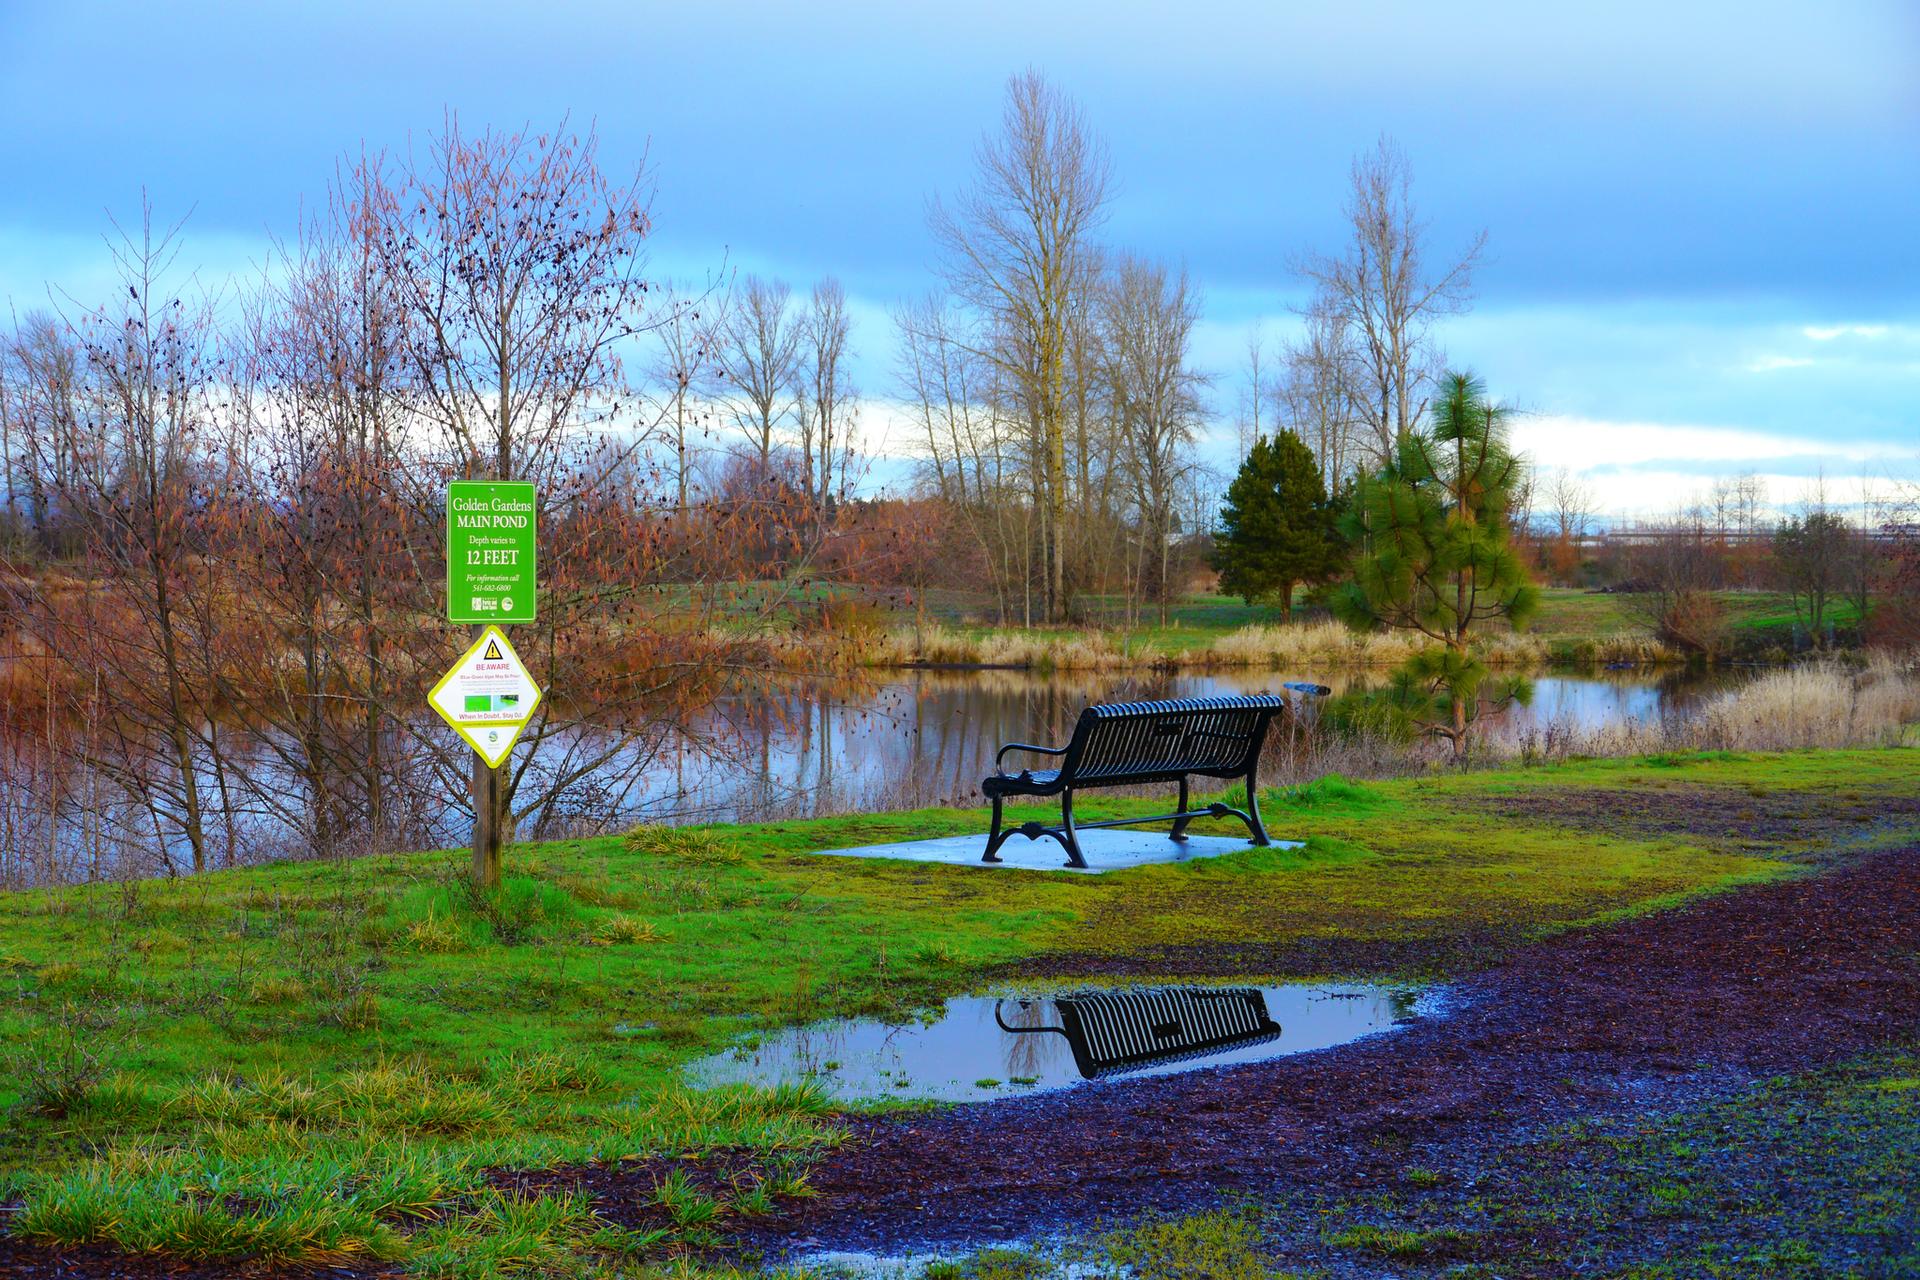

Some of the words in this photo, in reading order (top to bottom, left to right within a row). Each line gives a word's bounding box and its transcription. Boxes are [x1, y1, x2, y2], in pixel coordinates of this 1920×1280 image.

[453, 498, 488, 511] Golden
[492, 498, 532, 511] Gardens
[457, 515, 490, 528] MAIN
[493, 515, 527, 528] POND
[469, 536, 489, 547] Depth
[467, 550, 480, 565] 12
[483, 550, 519, 565] FEET
[466, 574, 476, 582] For
[477, 574, 508, 584] information
[509, 574, 520, 582] call
[476, 663, 485, 671] BE
[486, 663, 511, 671] AWARE
